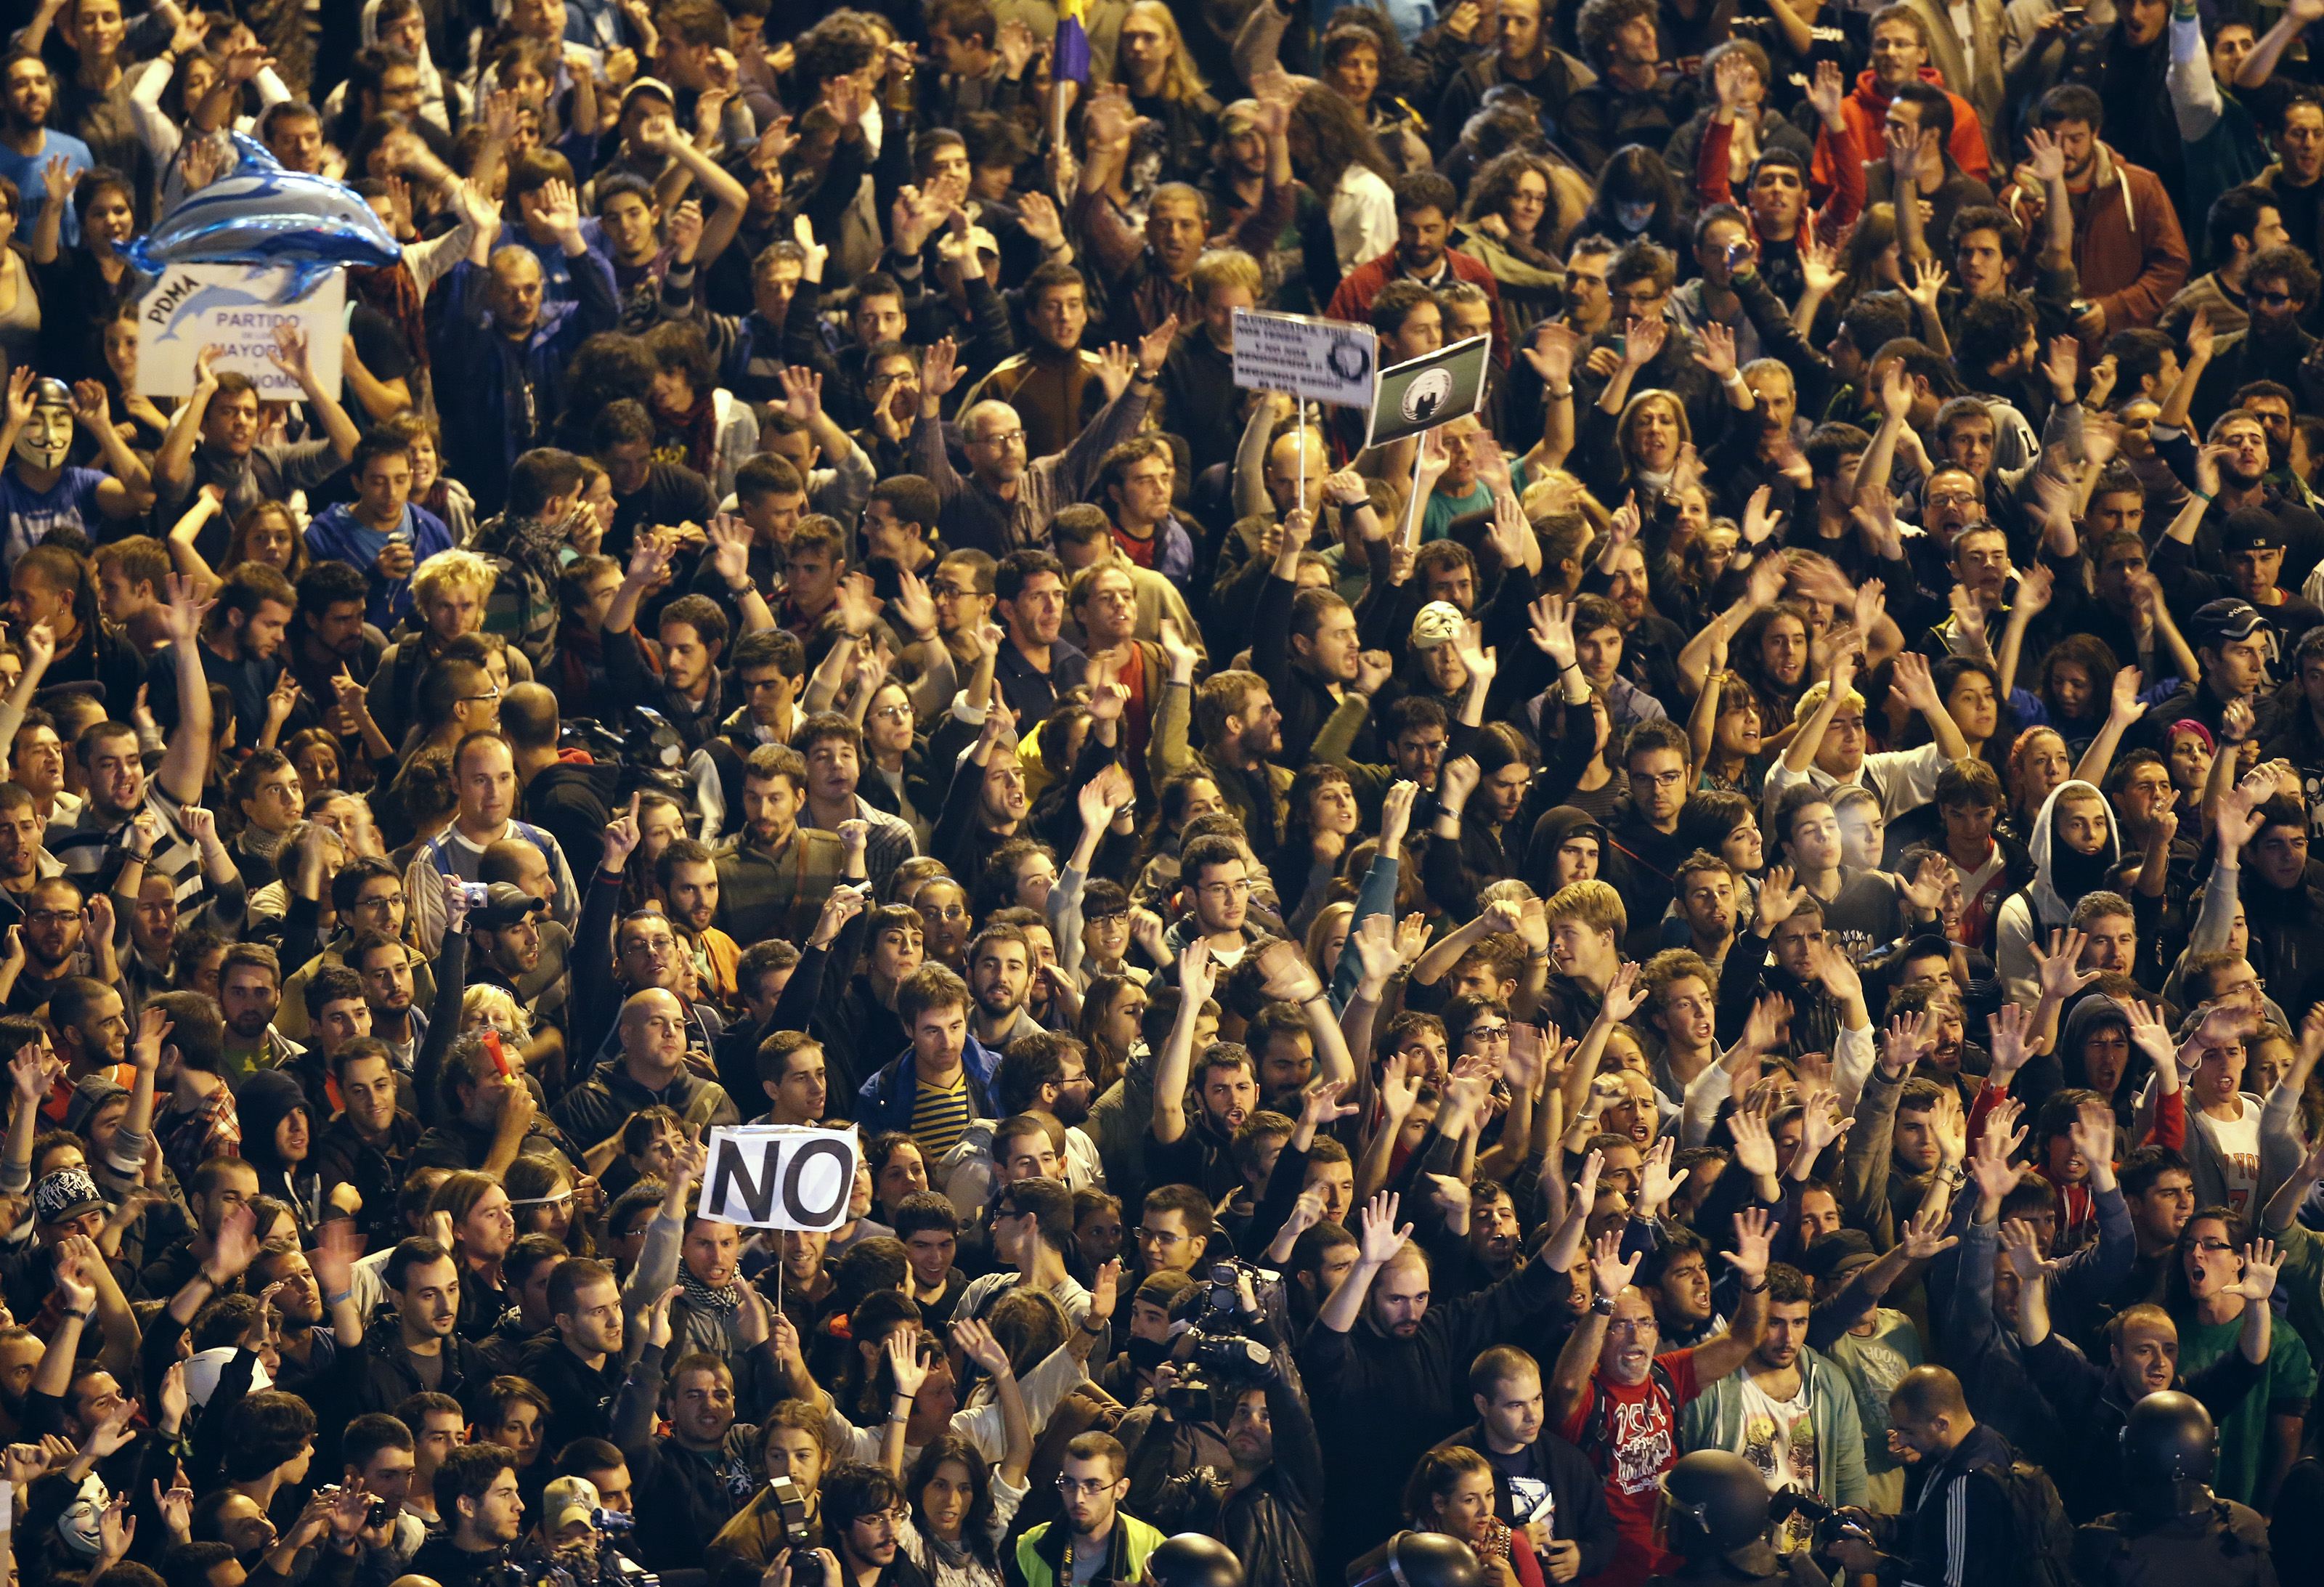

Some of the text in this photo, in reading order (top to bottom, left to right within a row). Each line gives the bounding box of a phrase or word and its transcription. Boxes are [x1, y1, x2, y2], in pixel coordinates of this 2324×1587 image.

[147, 275, 200, 325] PDMA
[216, 312, 300, 328] PARTIDO
[709, 1139, 853, 1227] NO
